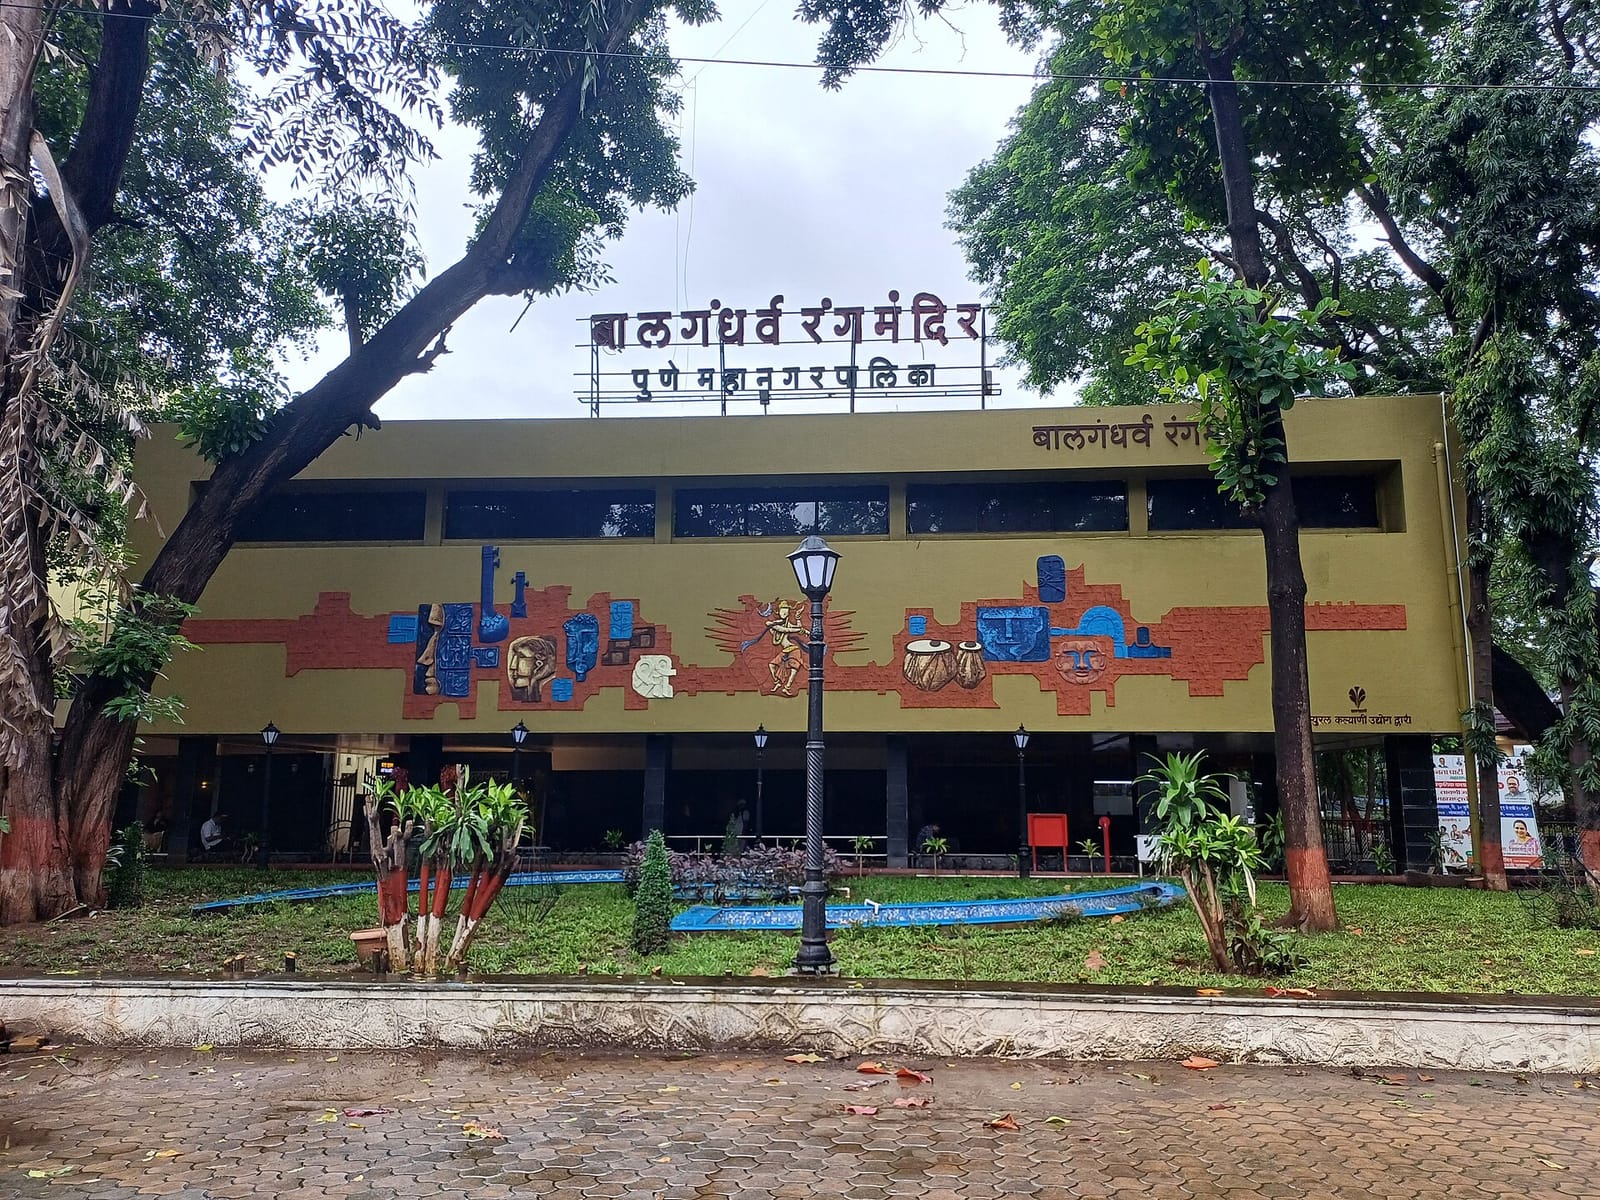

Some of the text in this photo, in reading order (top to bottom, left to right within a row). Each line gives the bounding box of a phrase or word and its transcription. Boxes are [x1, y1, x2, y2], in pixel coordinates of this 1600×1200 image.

[591, 290, 981, 349] बालगंधर्व रंगमंदिर
[631, 356, 936, 402] पुणे महानगरपालिका
[1032, 413, 1154, 450] बालगंधर्व
